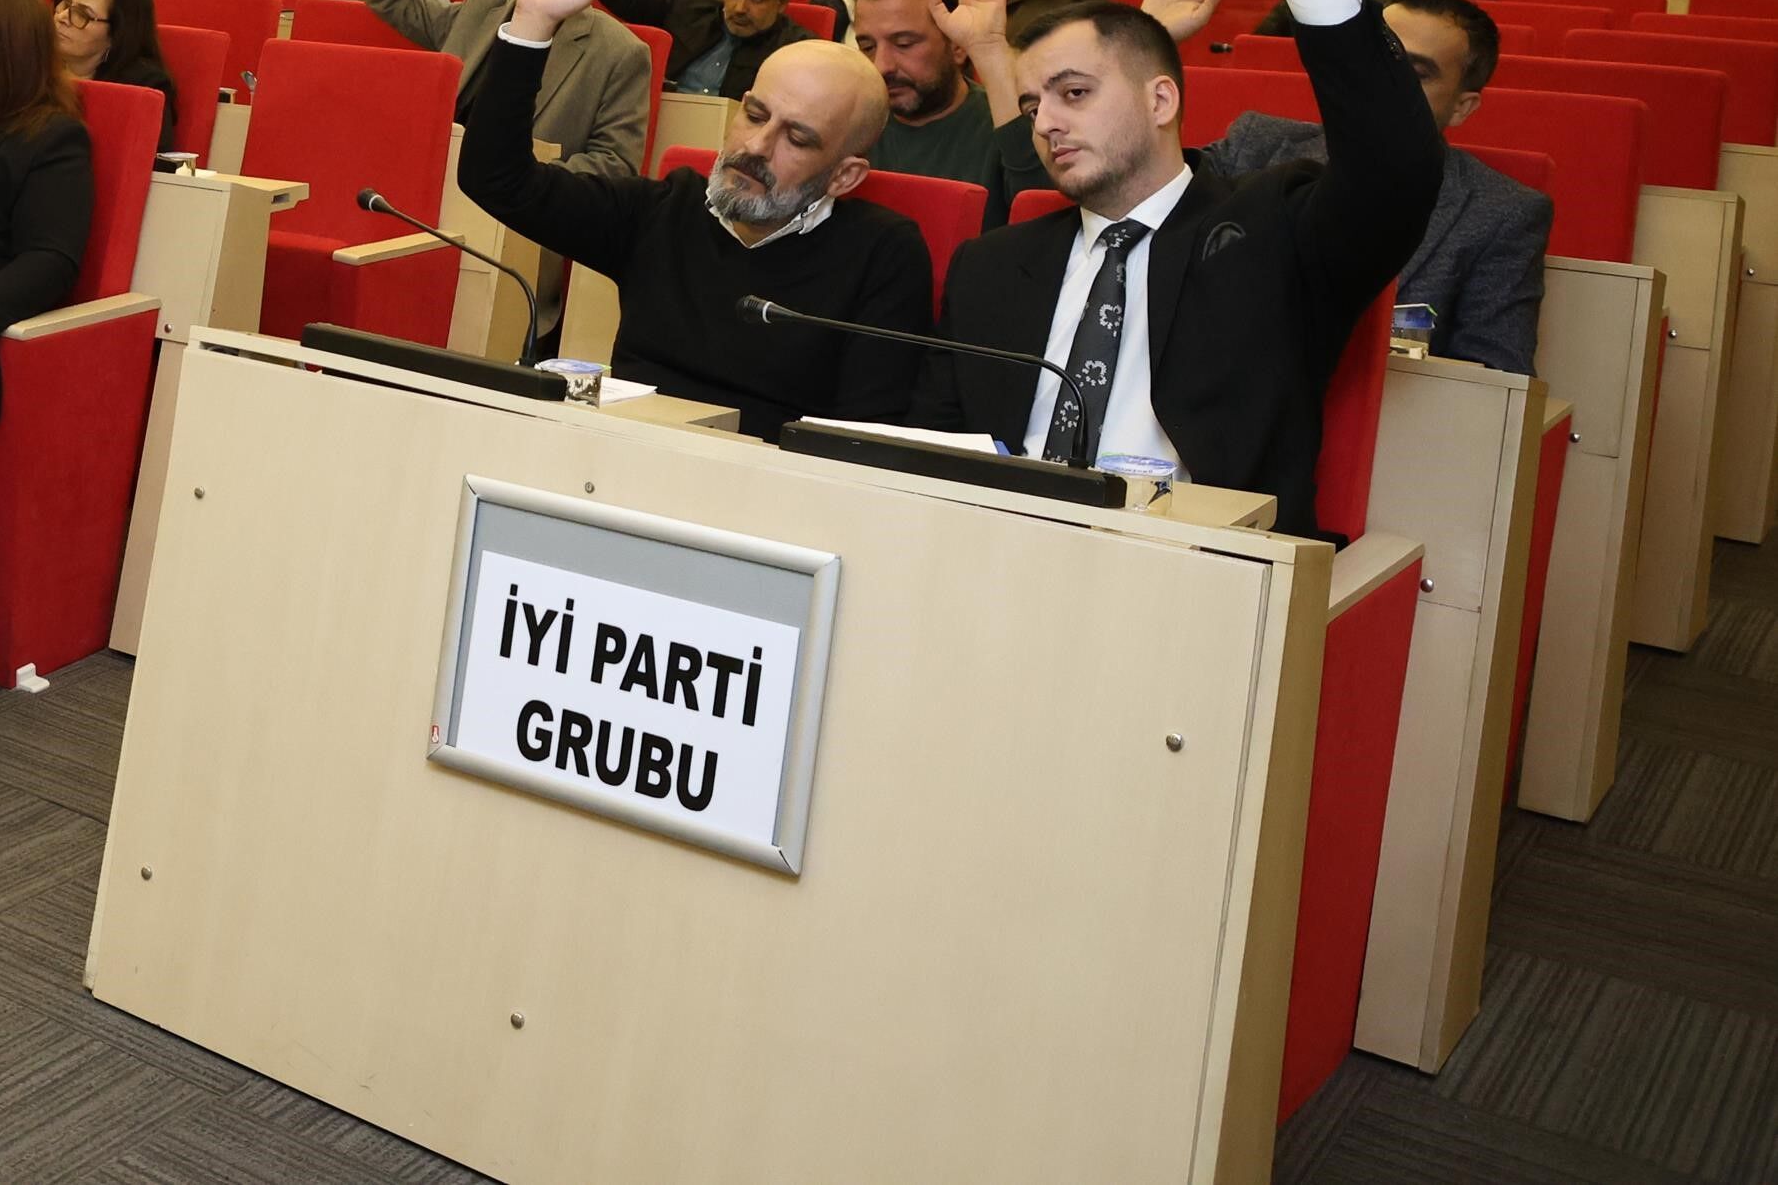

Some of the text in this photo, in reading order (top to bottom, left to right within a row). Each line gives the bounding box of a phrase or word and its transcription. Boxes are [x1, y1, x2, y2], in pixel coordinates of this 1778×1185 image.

[499, 583, 763, 727] İYİ PARTİ
[516, 699, 719, 812] GRUBU
